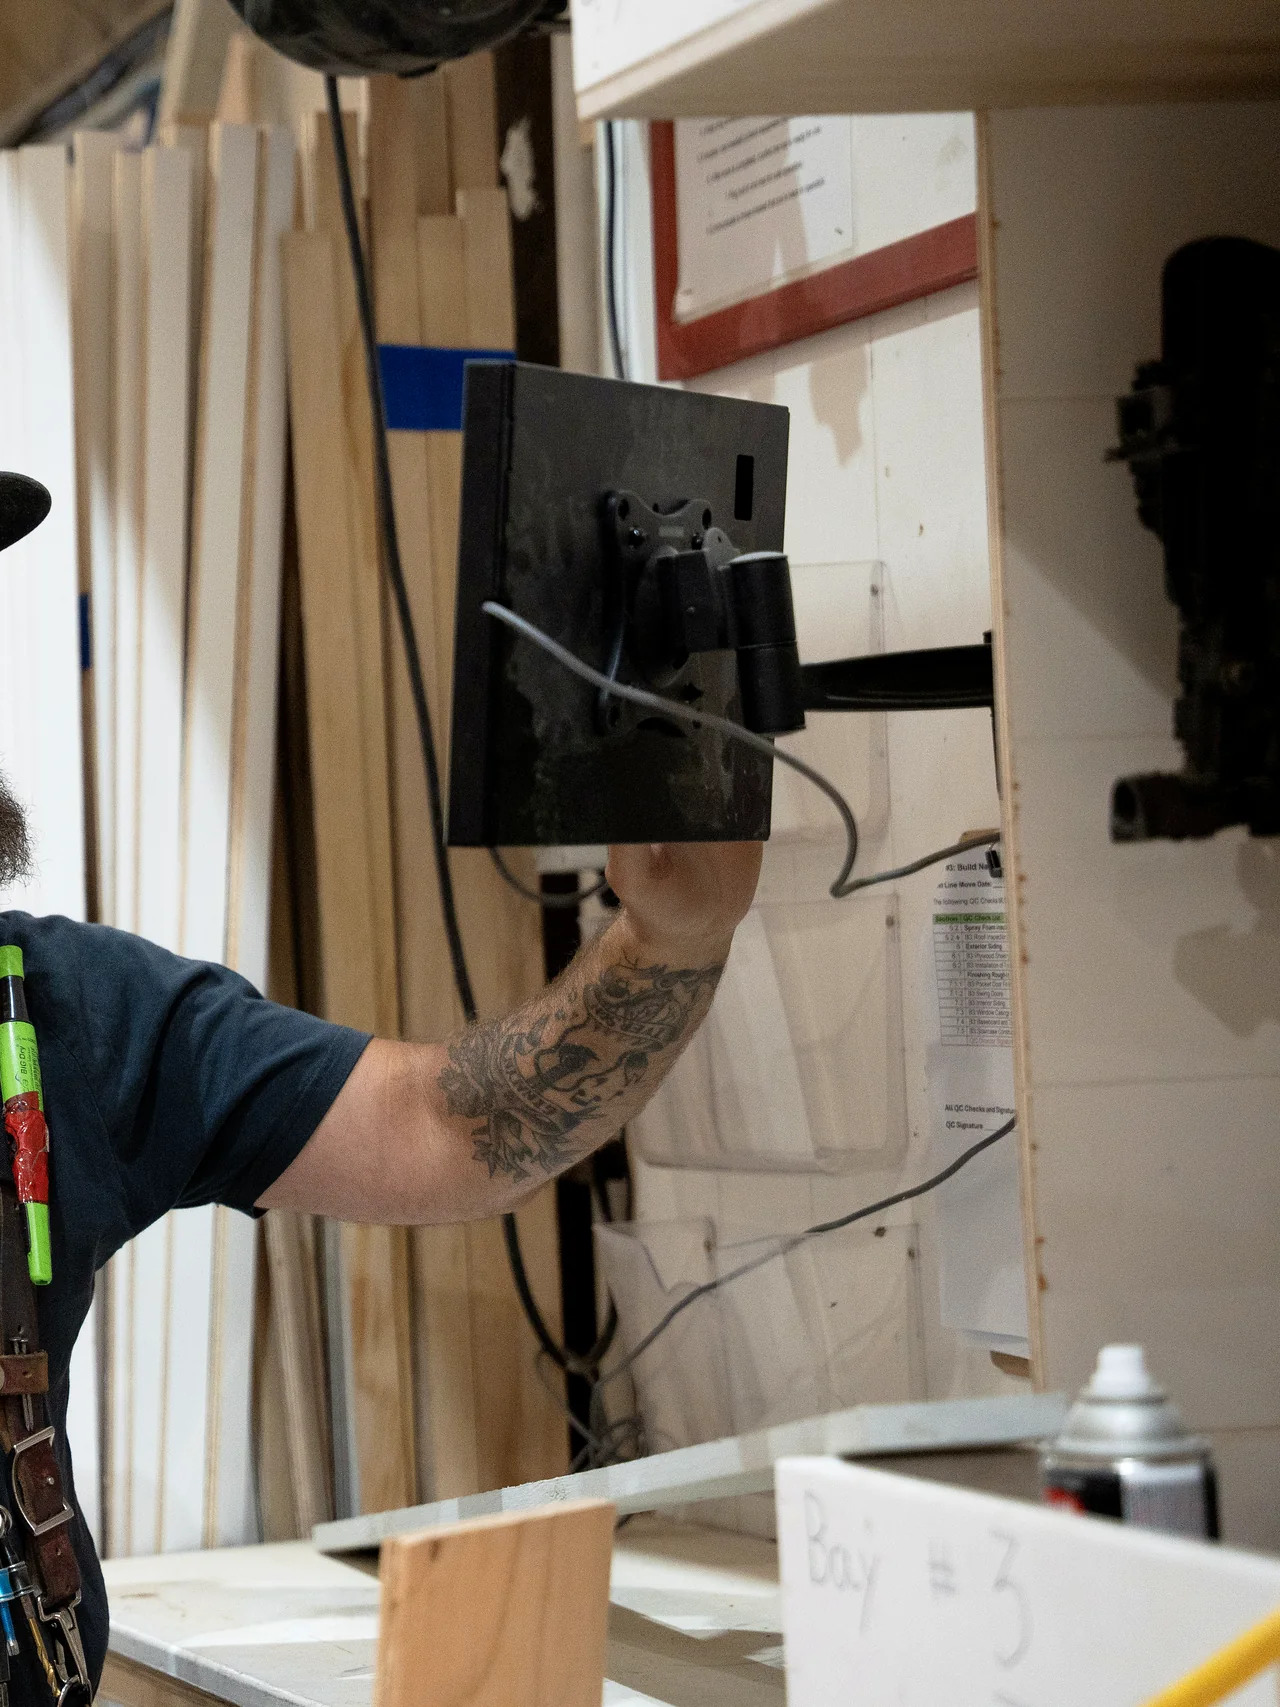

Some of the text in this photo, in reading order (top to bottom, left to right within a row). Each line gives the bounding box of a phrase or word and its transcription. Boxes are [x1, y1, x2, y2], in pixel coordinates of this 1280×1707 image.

[957, 862, 977, 872] Build
[18, 1045, 26, 1060] Dry
[20, 1061, 28, 1075] BIG
[954, 1104, 964, 1113] QC
[964, 1104, 985, 1112] Checks
[945, 1121, 983, 1130] QC Signature
[805, 1489, 881, 1637] Bay
[988, 1527, 1033, 1669] 3
